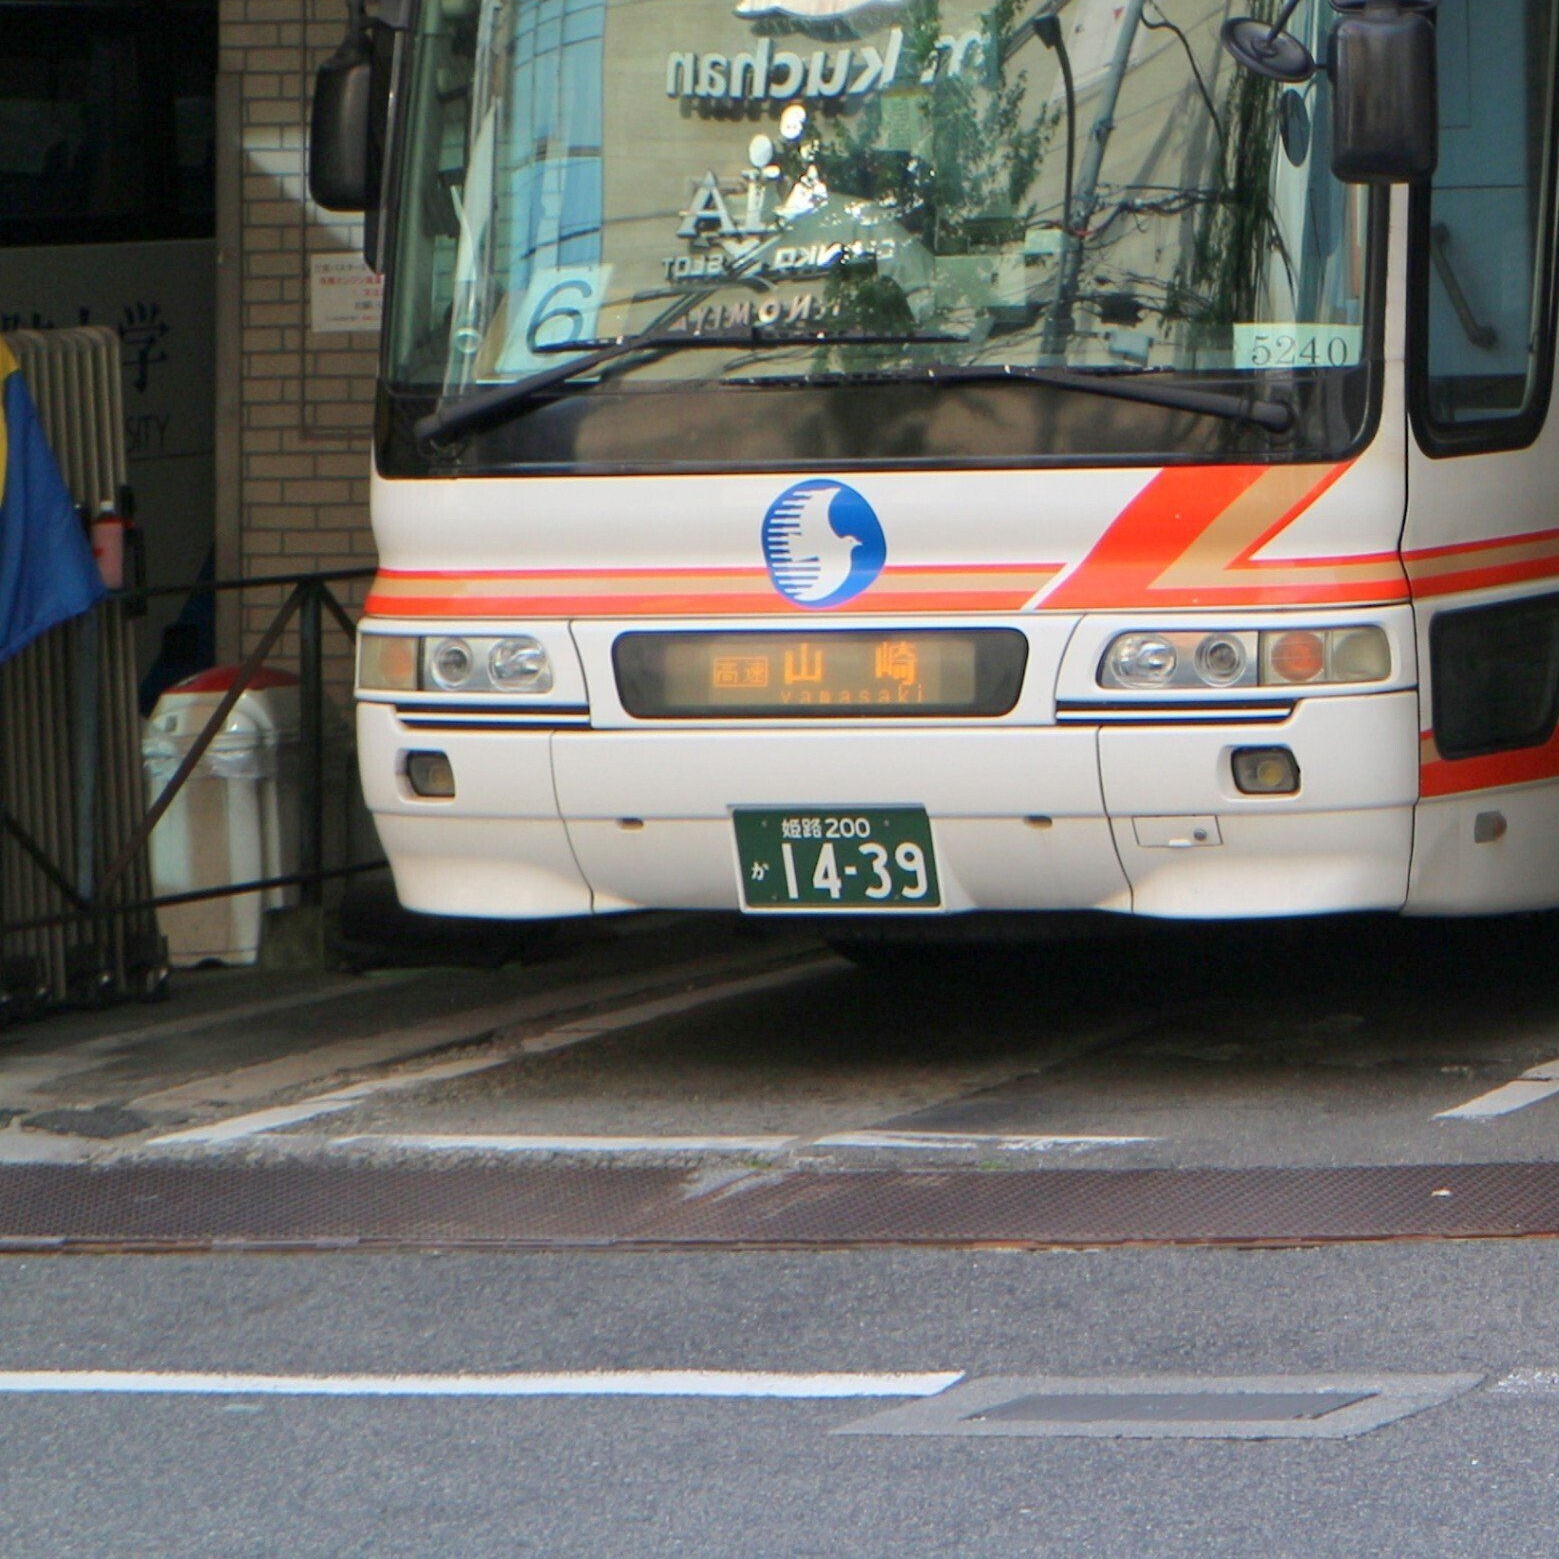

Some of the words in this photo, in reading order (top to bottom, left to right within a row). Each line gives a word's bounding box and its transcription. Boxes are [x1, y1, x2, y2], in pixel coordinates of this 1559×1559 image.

[1251, 335, 1348, 367] 5240
[714, 657, 768, 687] 高速
[784, 641, 918, 686] 山崎
[751, 861, 770, 881] か
[781, 842, 929, 900] 14-39
